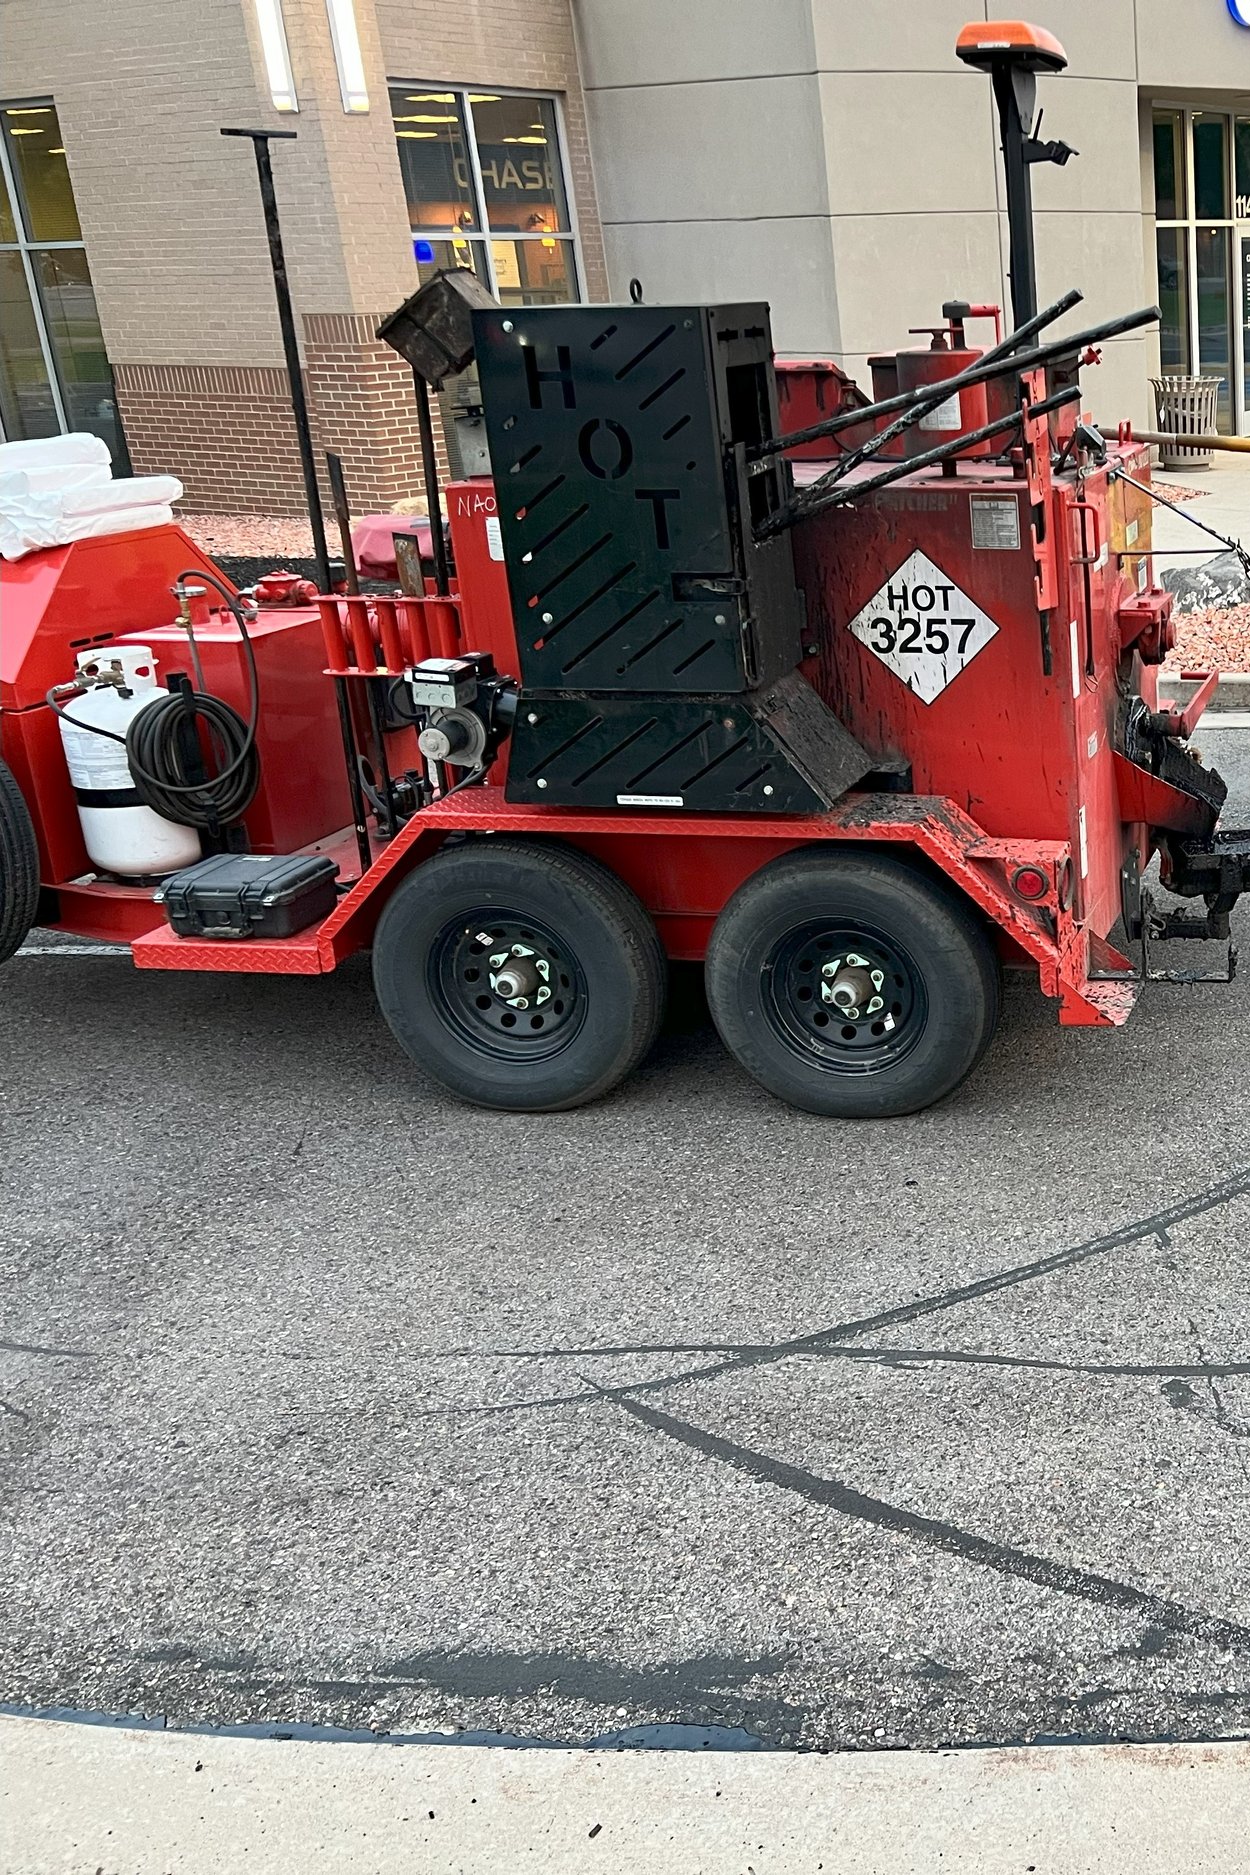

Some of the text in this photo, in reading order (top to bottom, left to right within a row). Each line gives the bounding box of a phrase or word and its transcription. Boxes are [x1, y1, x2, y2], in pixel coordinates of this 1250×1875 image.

[522, 345, 681, 550] HOT
[887, 585, 955, 611] HOT
[870, 617, 976, 655] 3257
